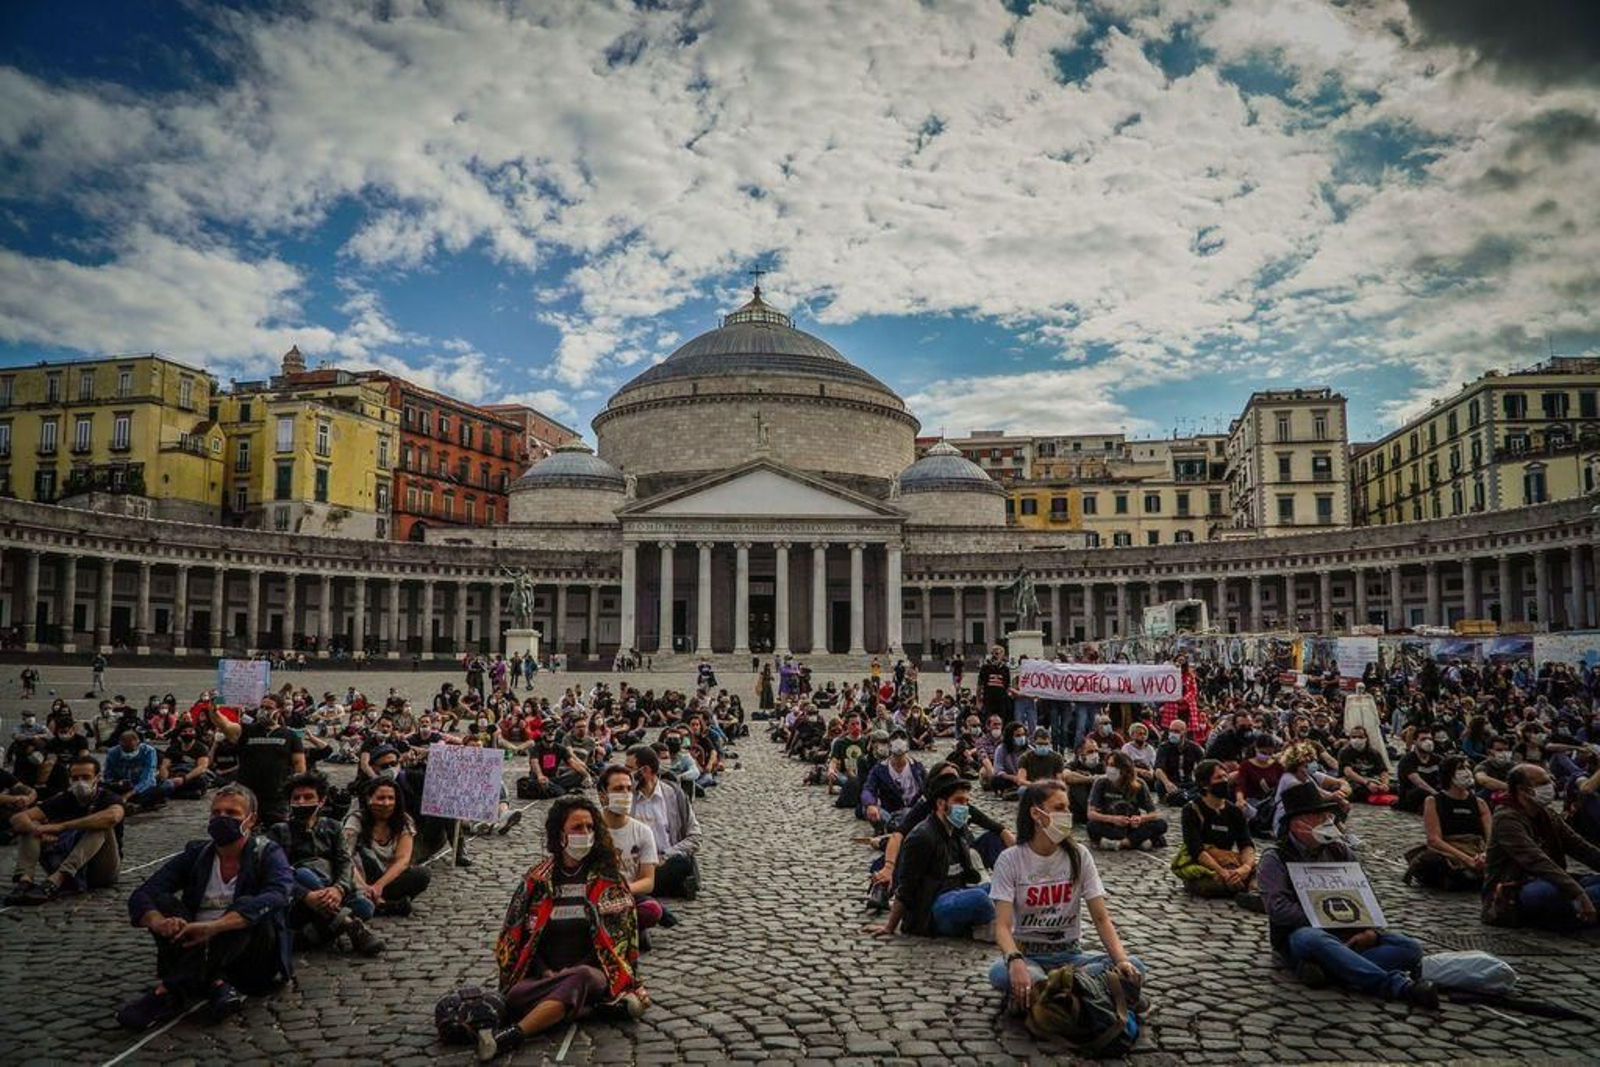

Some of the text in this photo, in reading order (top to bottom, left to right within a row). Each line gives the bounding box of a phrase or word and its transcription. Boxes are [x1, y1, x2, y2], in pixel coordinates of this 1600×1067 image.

[1020, 673, 1110, 693] #CONVOCATECI
[1118, 676, 1135, 694] DAL
[1142, 675, 1177, 695] VIVO
[1026, 883, 1073, 906] SAVE
